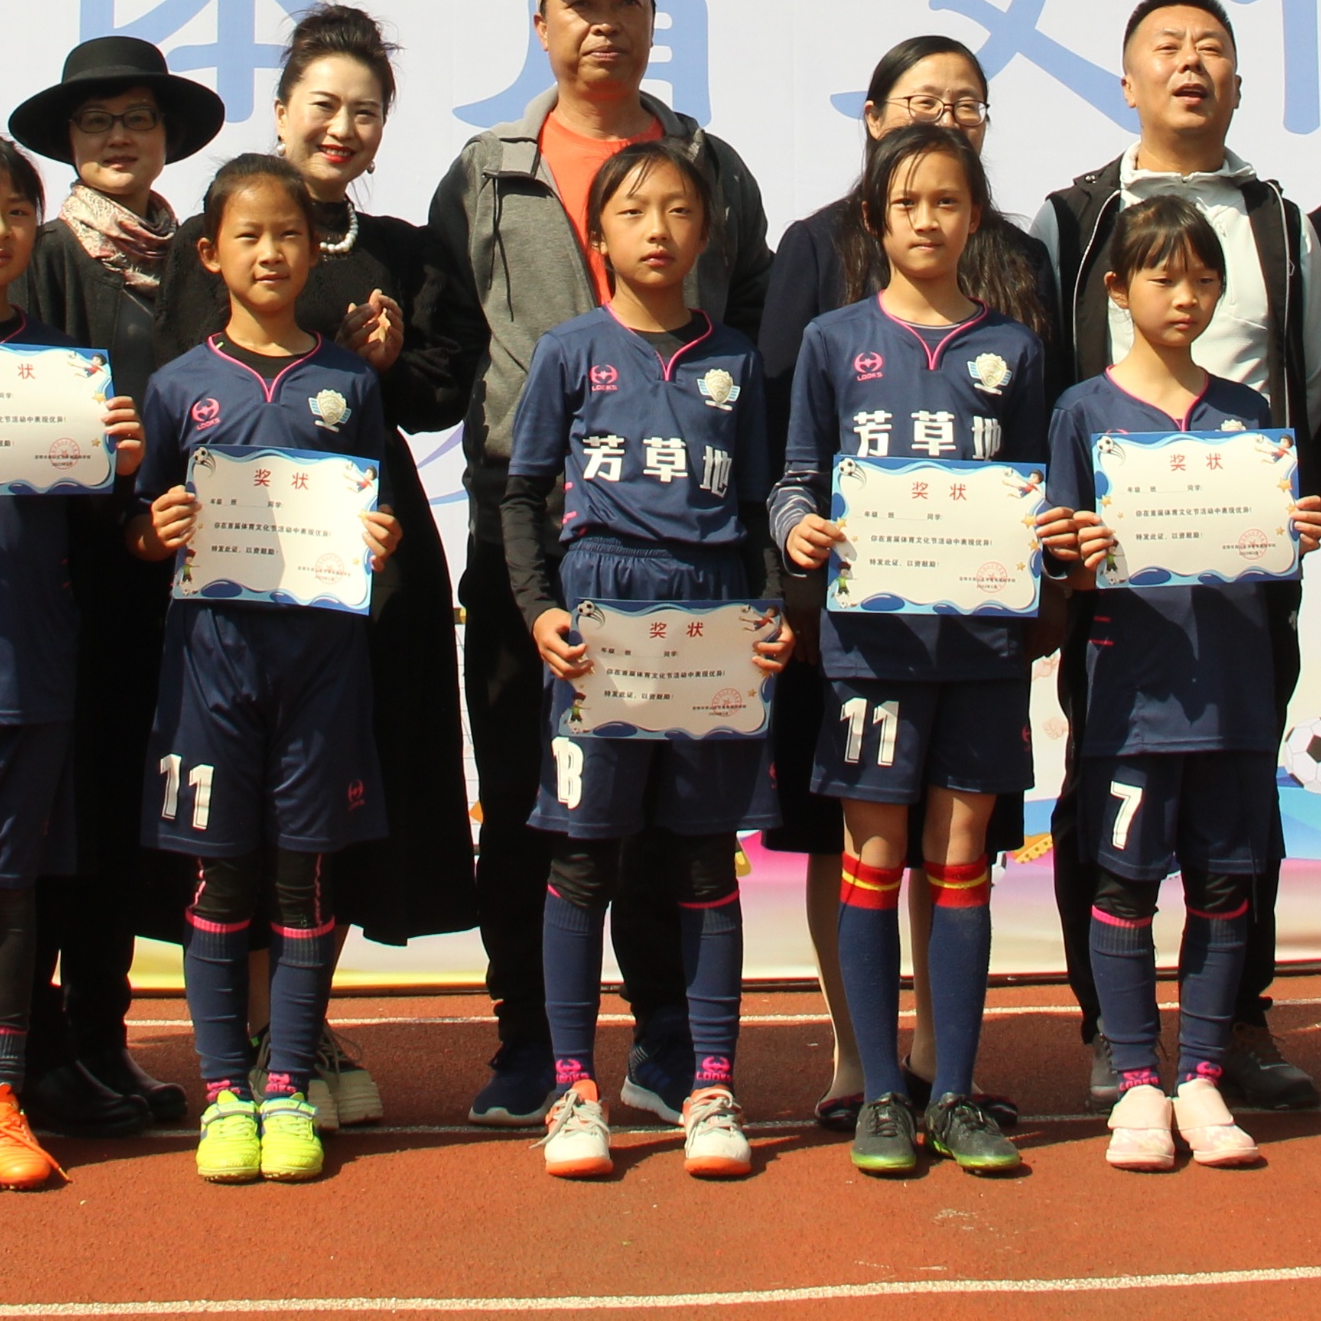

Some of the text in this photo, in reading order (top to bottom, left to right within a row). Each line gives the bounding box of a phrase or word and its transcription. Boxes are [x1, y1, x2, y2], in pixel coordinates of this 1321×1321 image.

[857, 371, 882, 381] LOOKS
[196, 418, 221, 431] LOOKS
[582, 434, 733, 498] 芳草地
[1170, 453, 1223, 471] 奖状
[254, 469, 309, 490] 奖状
[912, 482, 967, 501] 奖状
[649, 622, 704, 638] 奖状
[839, 697, 899, 767] 11
[160, 753, 215, 831] 11
[1109, 780, 1143, 850] 7
